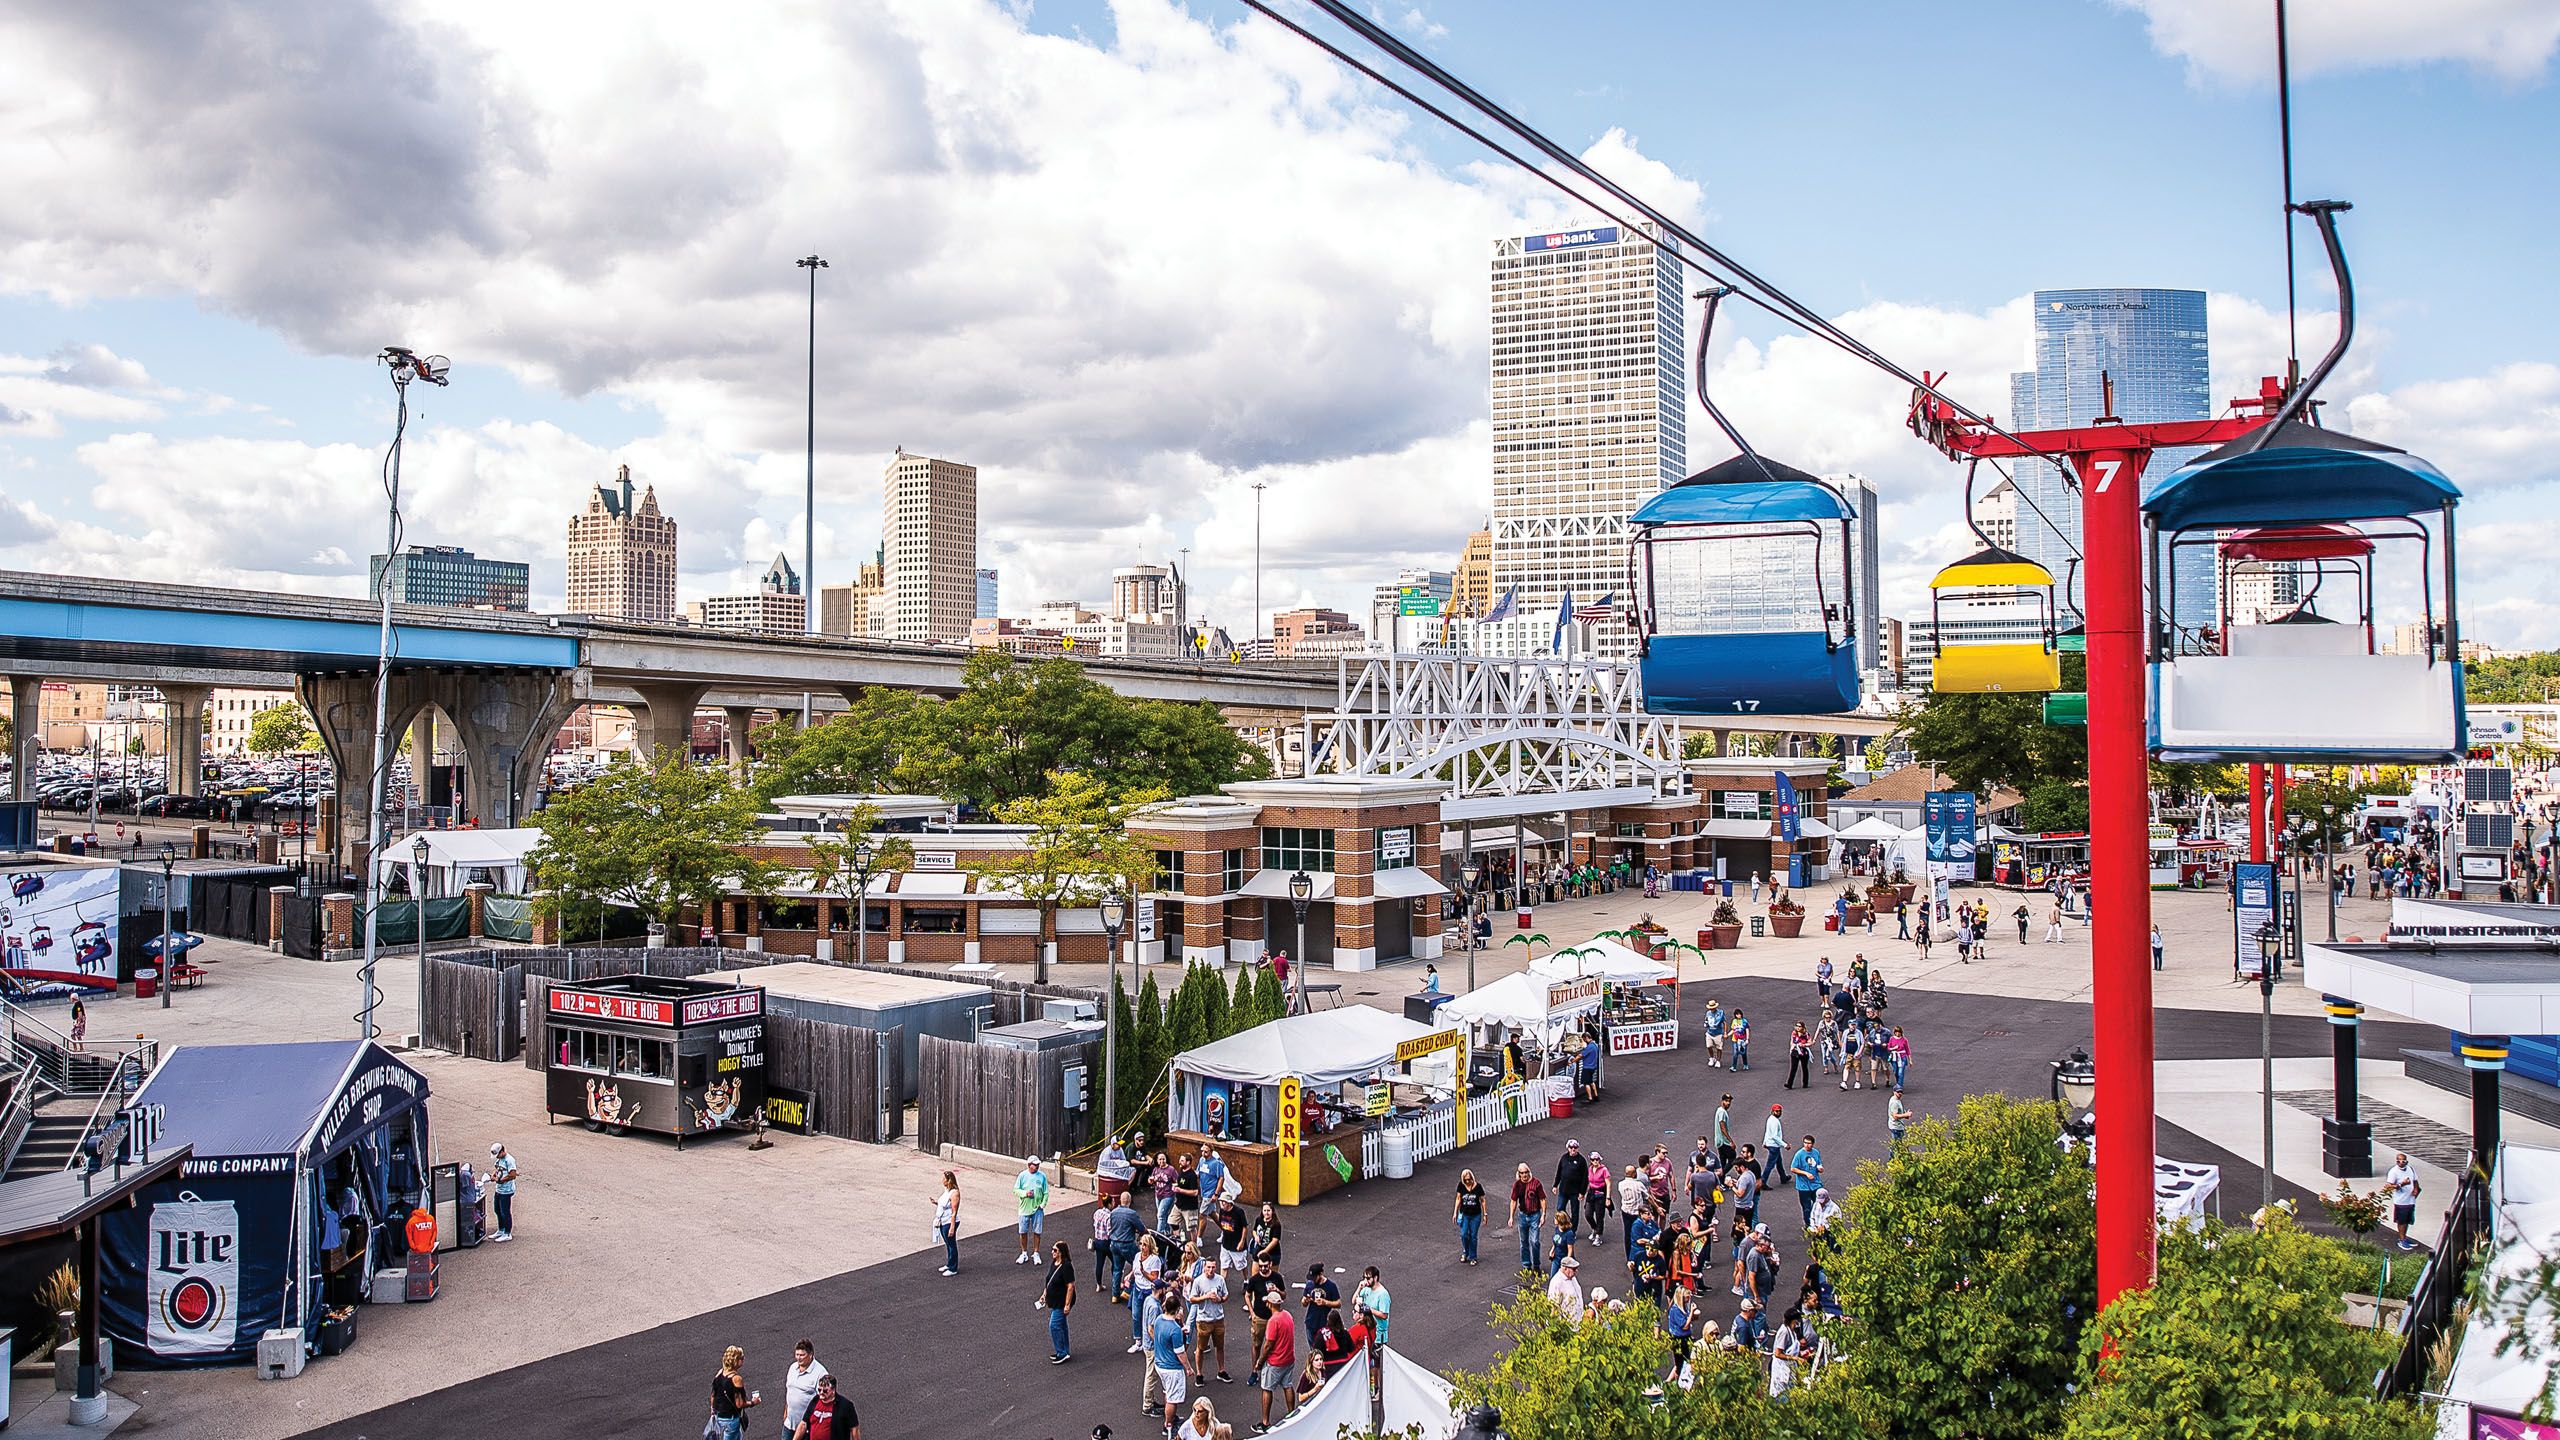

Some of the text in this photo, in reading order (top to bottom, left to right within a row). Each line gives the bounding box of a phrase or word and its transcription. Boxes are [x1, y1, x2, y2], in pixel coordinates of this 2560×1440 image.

[2066, 303, 2120, 311] Northwestern
[2095, 461, 2122, 493] 7
[436, 546, 457, 554] CHASE
[1986, 683, 2002, 691] 16
[1732, 700, 1760, 711] 17
[918, 856, 951, 864] SERVICES
[1550, 978, 1600, 1008] KETTLE CORN
[560, 993, 585, 1012] 102.9
[620, 1000, 637, 1018] THE
[640, 1003, 659, 1020] HOG
[721, 998, 737, 1015] THE
[739, 996, 756, 1013] HOG
[1612, 1023, 1675, 1035] HAND-ROLLED PREMIUM
[727, 1040, 755, 1057] DOING IT
[1399, 1031, 1455, 1058] ROASTED CORN
[1613, 1031, 1674, 1051] CIGARS
[718, 1052, 764, 1073] HOGGY STYLE!
[1368, 1092, 1388, 1100] CORN
[321, 1065, 417, 1154] MILLER BREWING COMPANY
[363, 1094, 382, 1124] SHOP
[1283, 1085, 1296, 1158] CORN
[117, 1102, 167, 1163] Lite
[222, 1157, 289, 1173] COMPANY
[155, 1231, 232, 1275] Lite
